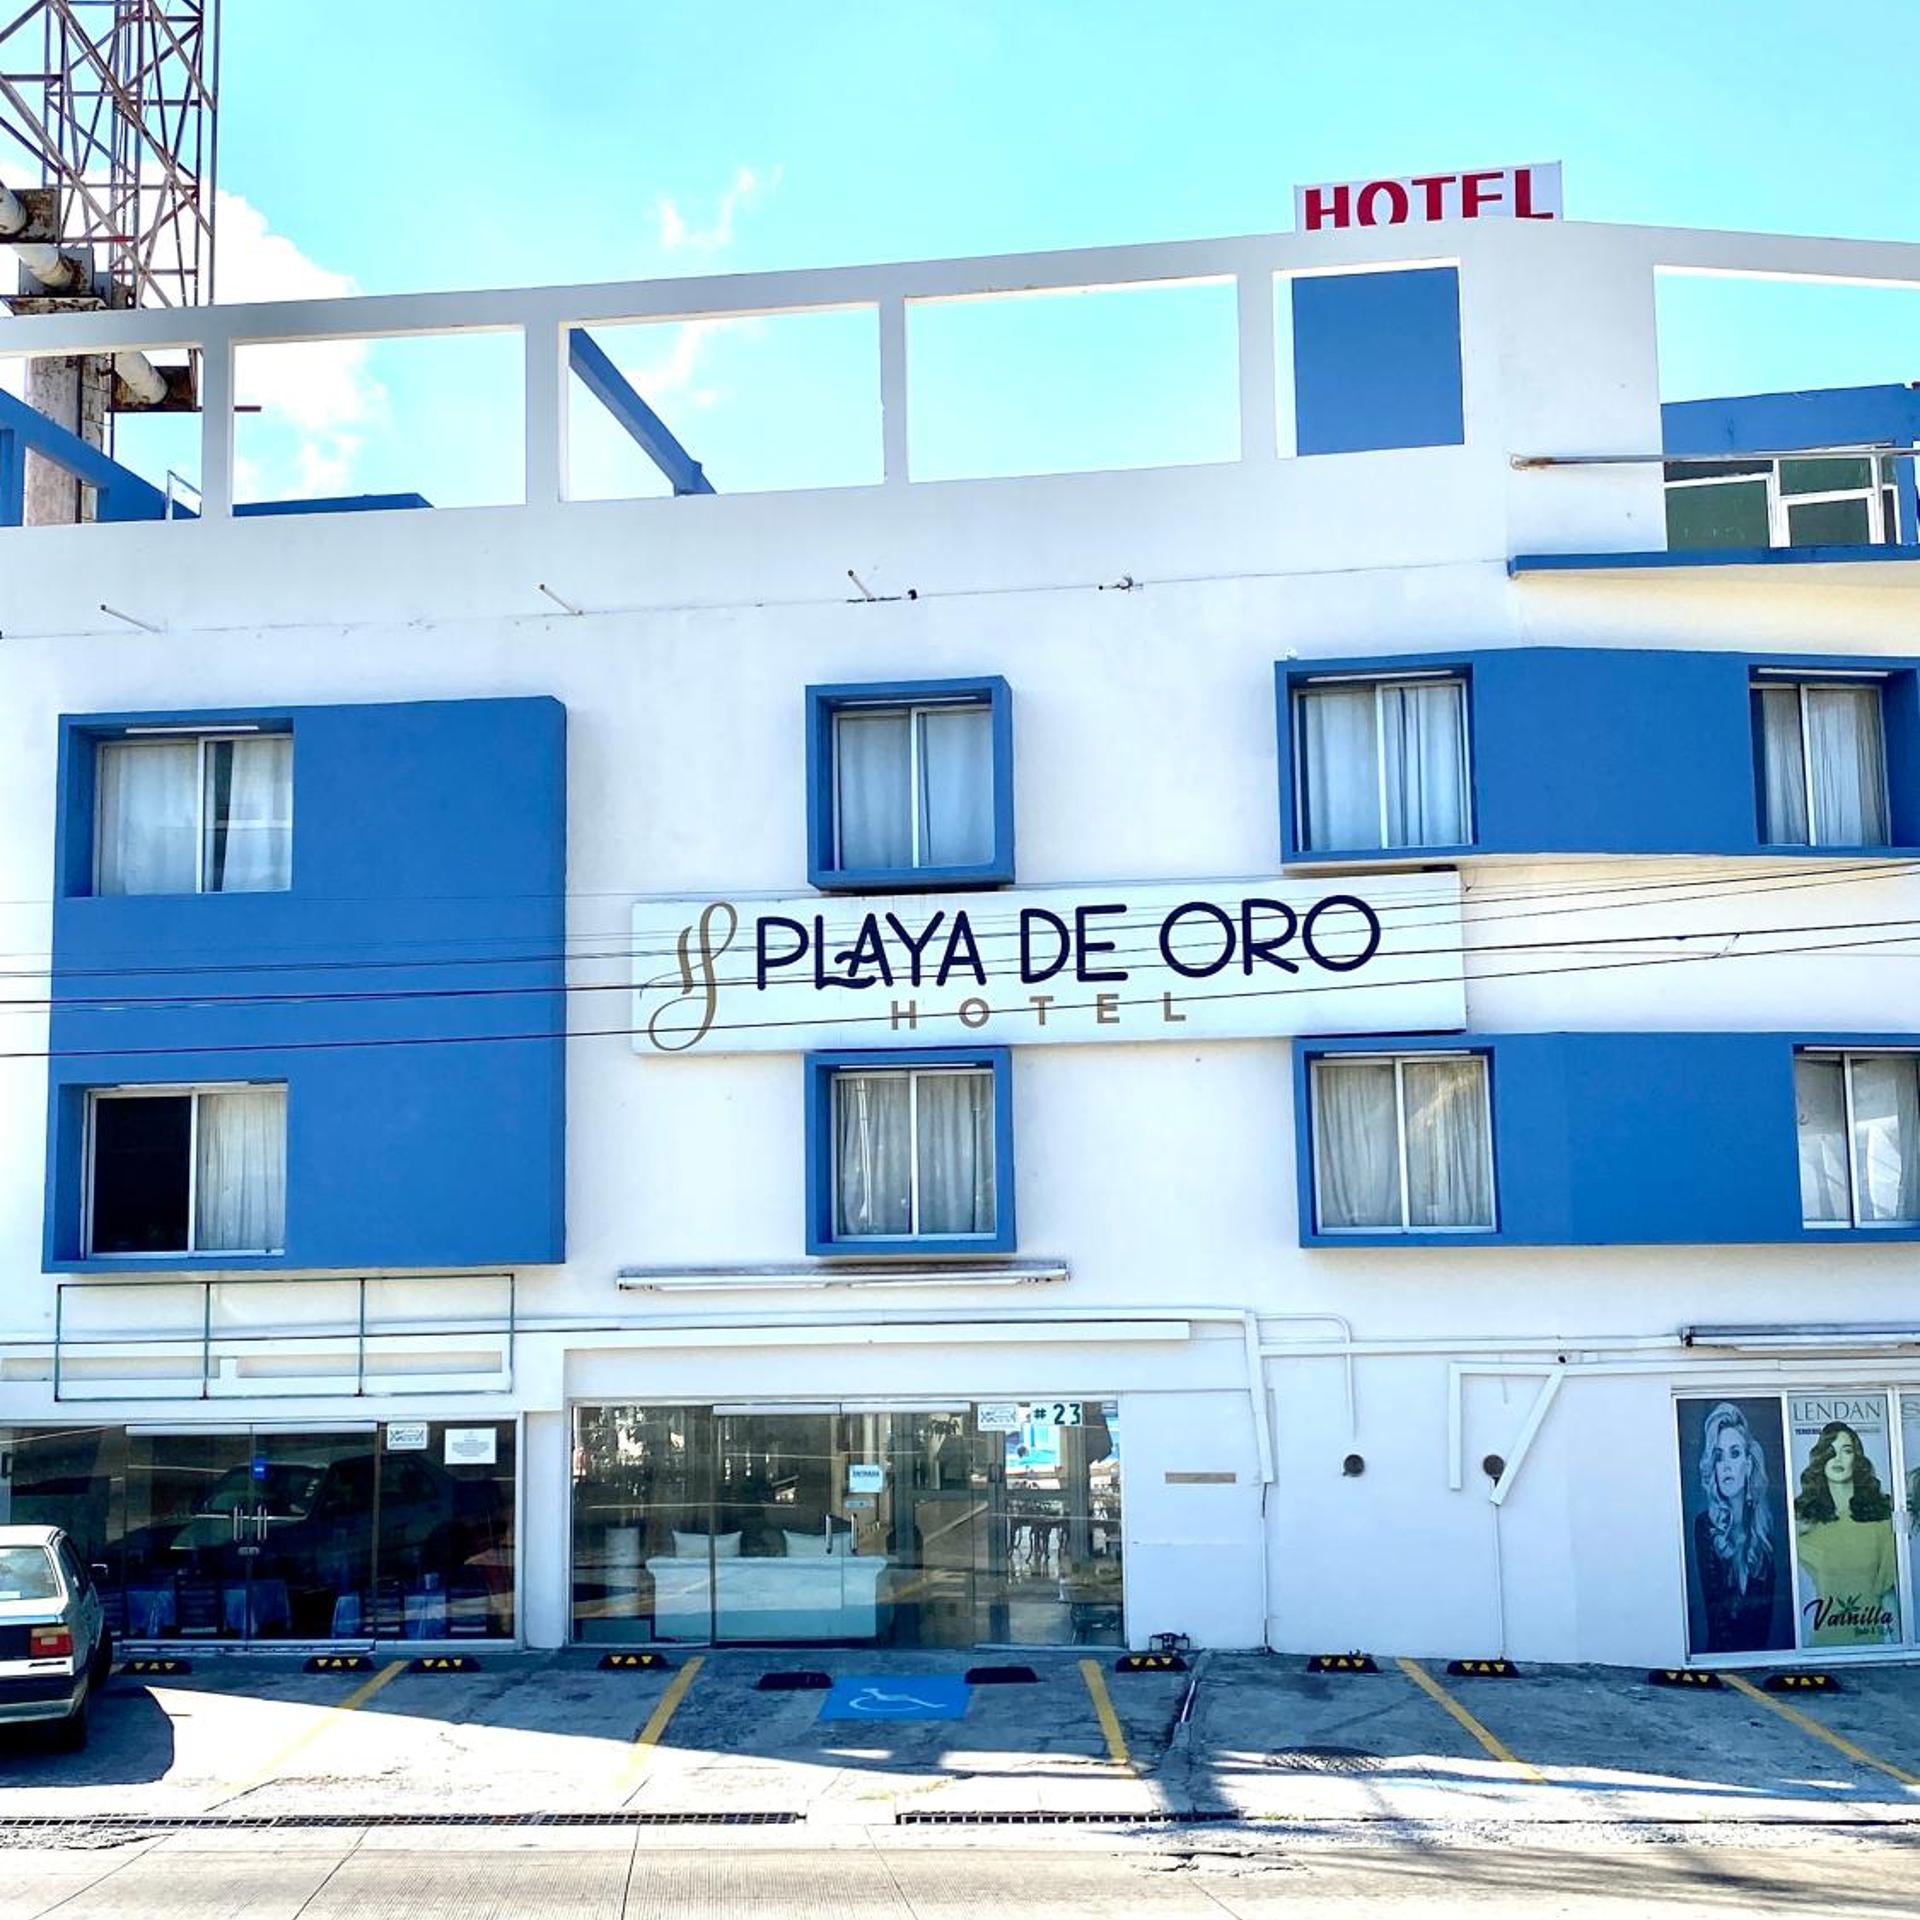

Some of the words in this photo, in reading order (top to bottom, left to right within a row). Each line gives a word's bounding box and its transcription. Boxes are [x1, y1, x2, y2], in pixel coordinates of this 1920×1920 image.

[1304, 169, 1554, 231] HOTEL
[756, 910, 987, 991] PLAYA
[1020, 904, 1129, 984] DE
[1159, 894, 1381, 978] ORO
[891, 991, 1187, 1031] HOTEL
[1793, 1401, 1880, 1420] LENDAN
